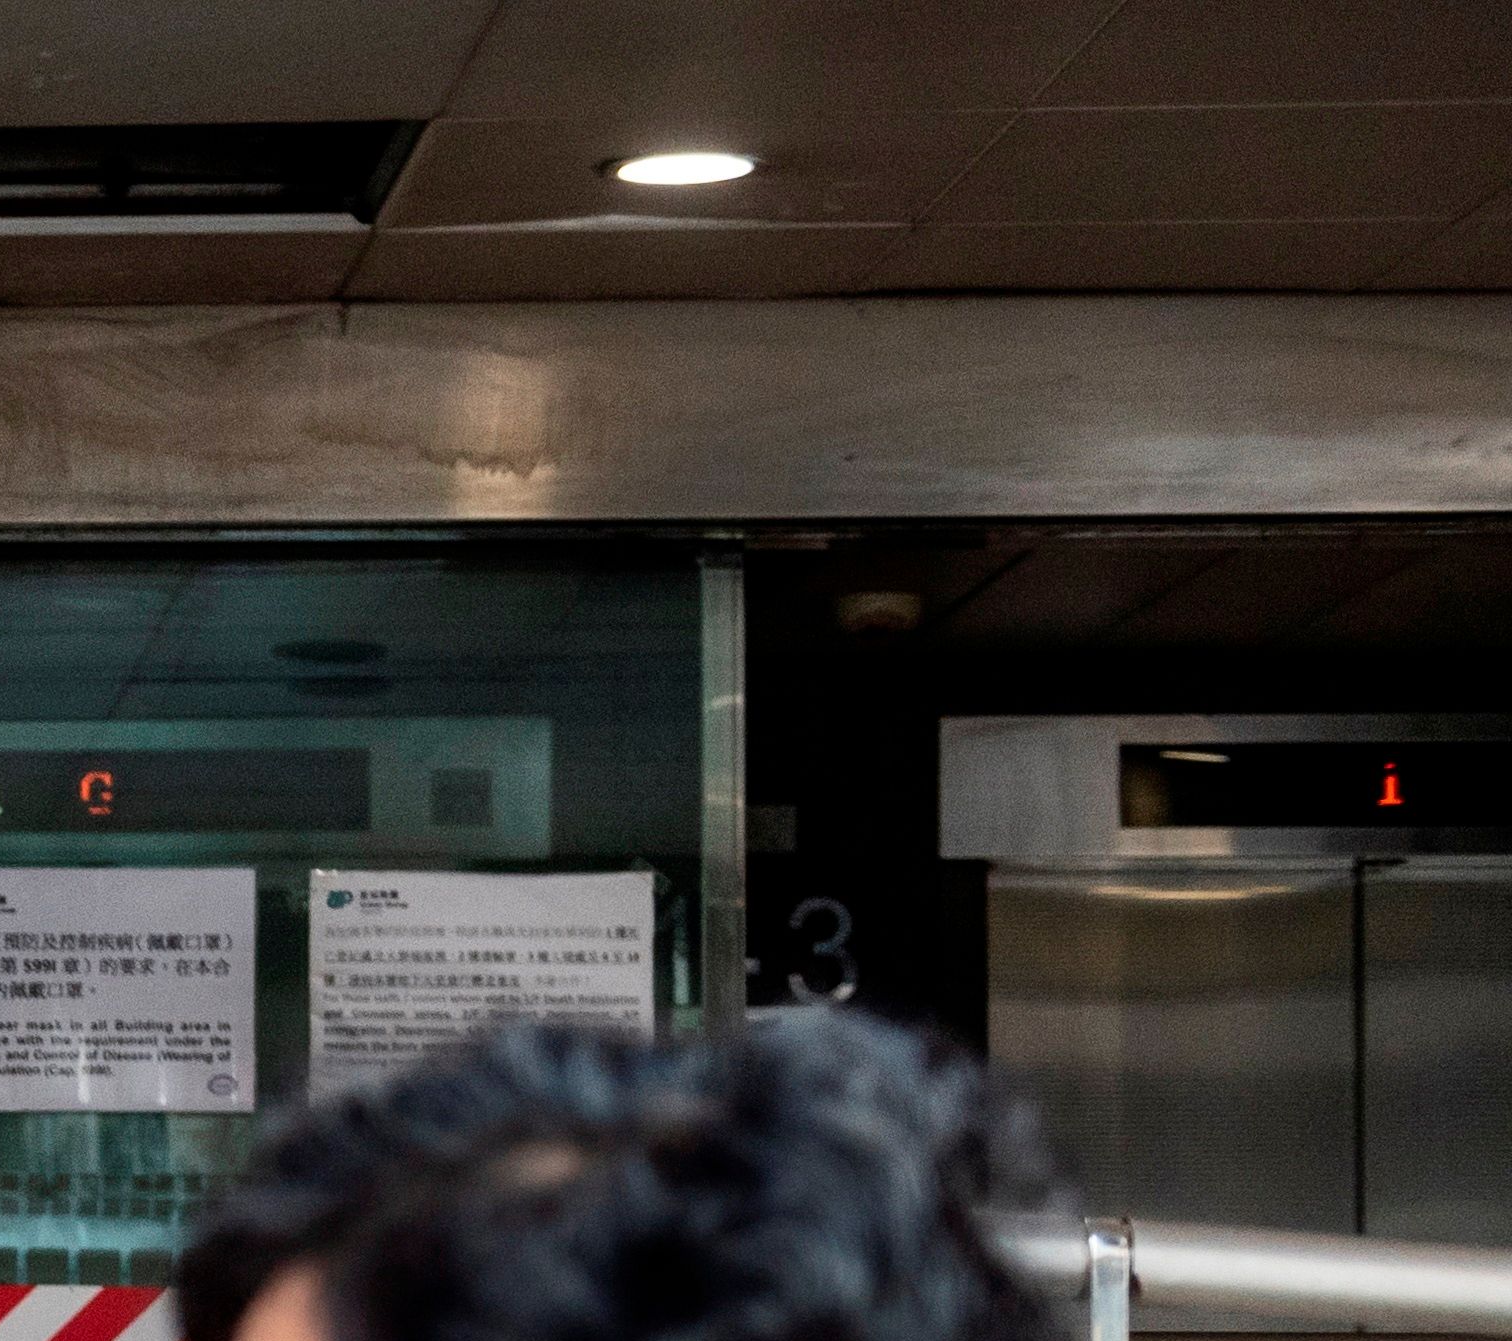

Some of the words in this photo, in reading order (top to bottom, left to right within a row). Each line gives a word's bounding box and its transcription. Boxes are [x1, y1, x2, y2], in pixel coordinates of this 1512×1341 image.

[79, 772, 114, 824] G
[70, 1019, 83, 1031] in
[180, 1022, 210, 1031] area
[217, 1019, 232, 1031] in
[16, 1034, 43, 1046] with
[209, 1034, 231, 1046] the
[6, 1049, 29, 1061] and
